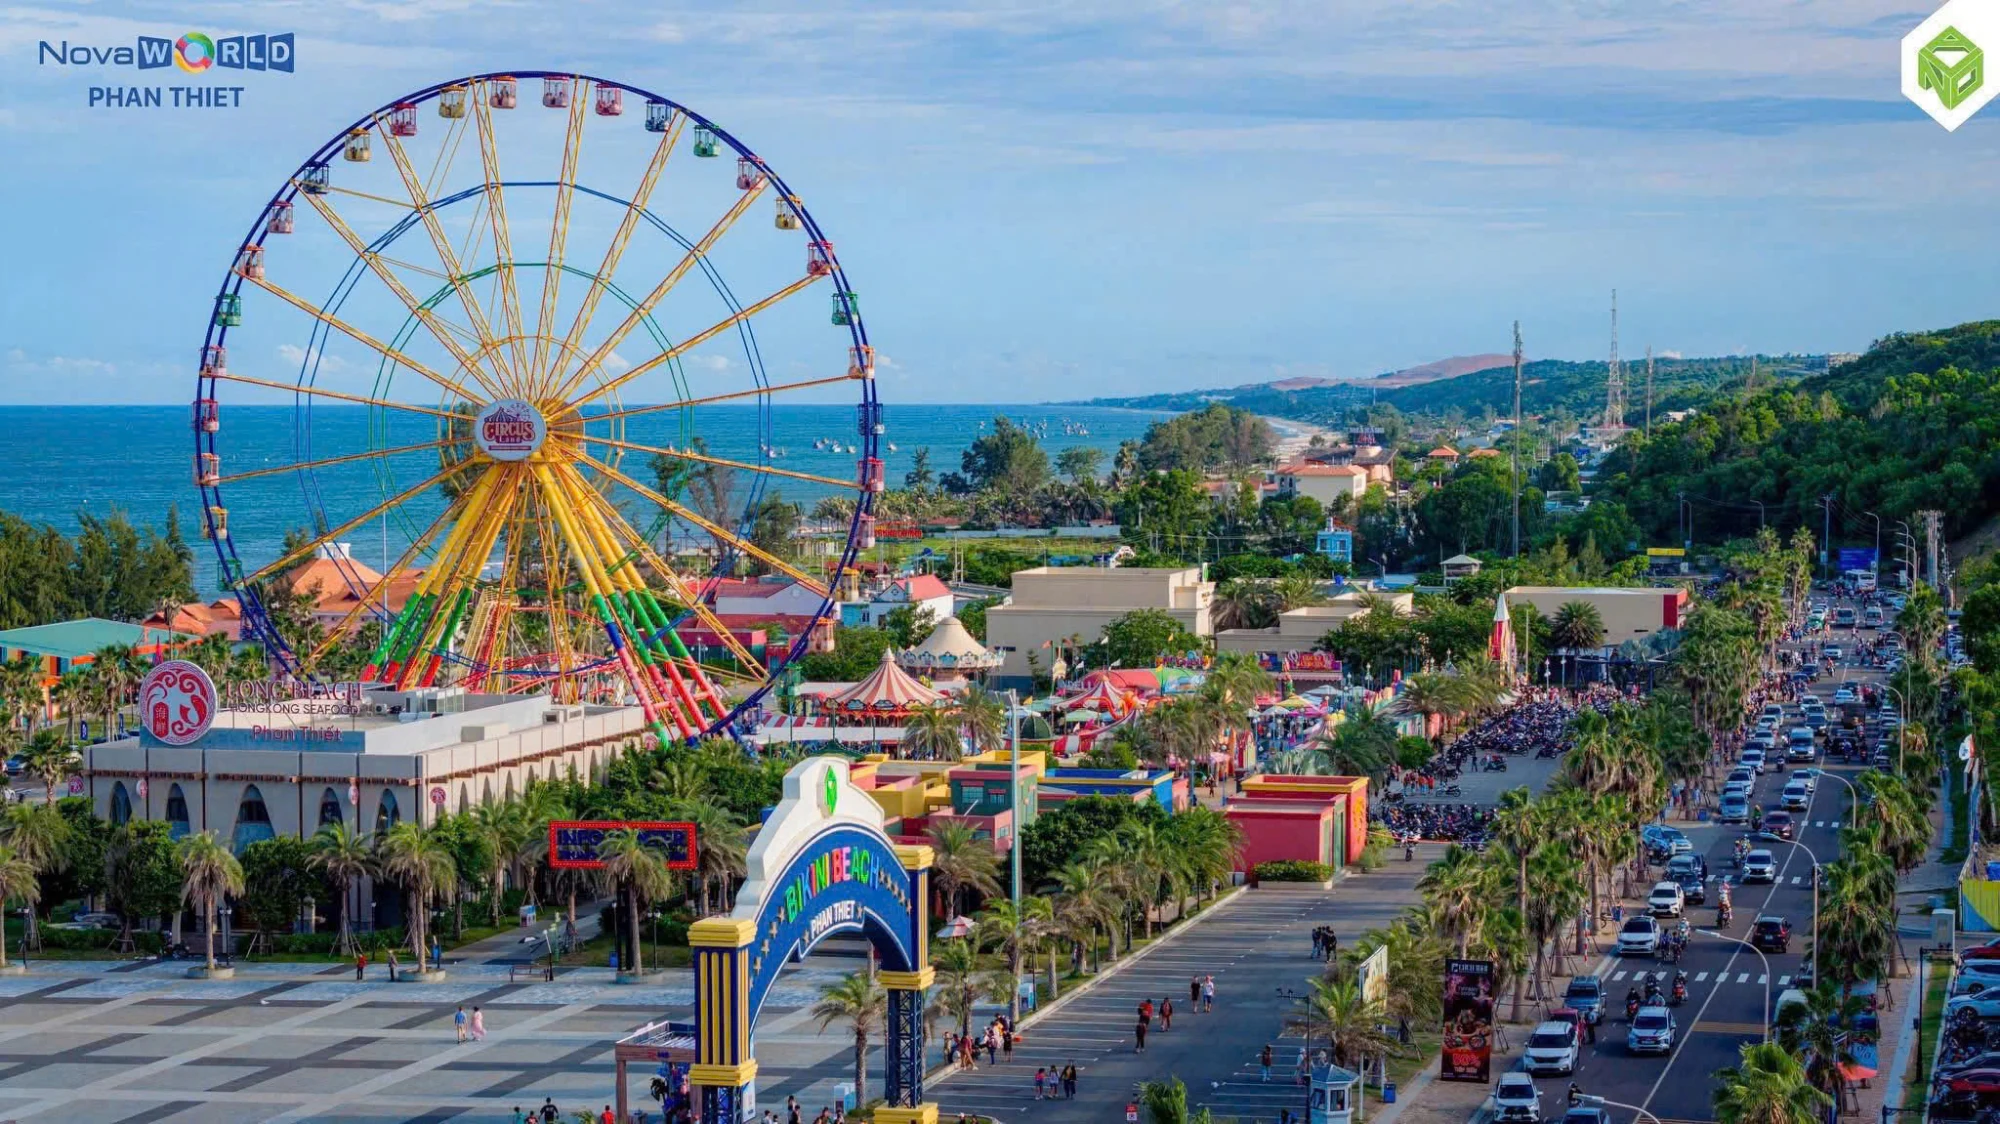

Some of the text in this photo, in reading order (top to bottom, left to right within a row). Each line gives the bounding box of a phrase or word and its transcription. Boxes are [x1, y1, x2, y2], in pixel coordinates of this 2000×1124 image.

[483, 421, 535, 441] CIRCUS
[225, 680, 285, 699] LONG
[231, 703, 360, 715] HONGKONG SEAFOOD
[252, 725, 295, 740] Phan
[784, 846, 880, 923] BIKINI BEACH
[811, 900, 856, 939] PHAN THIET
